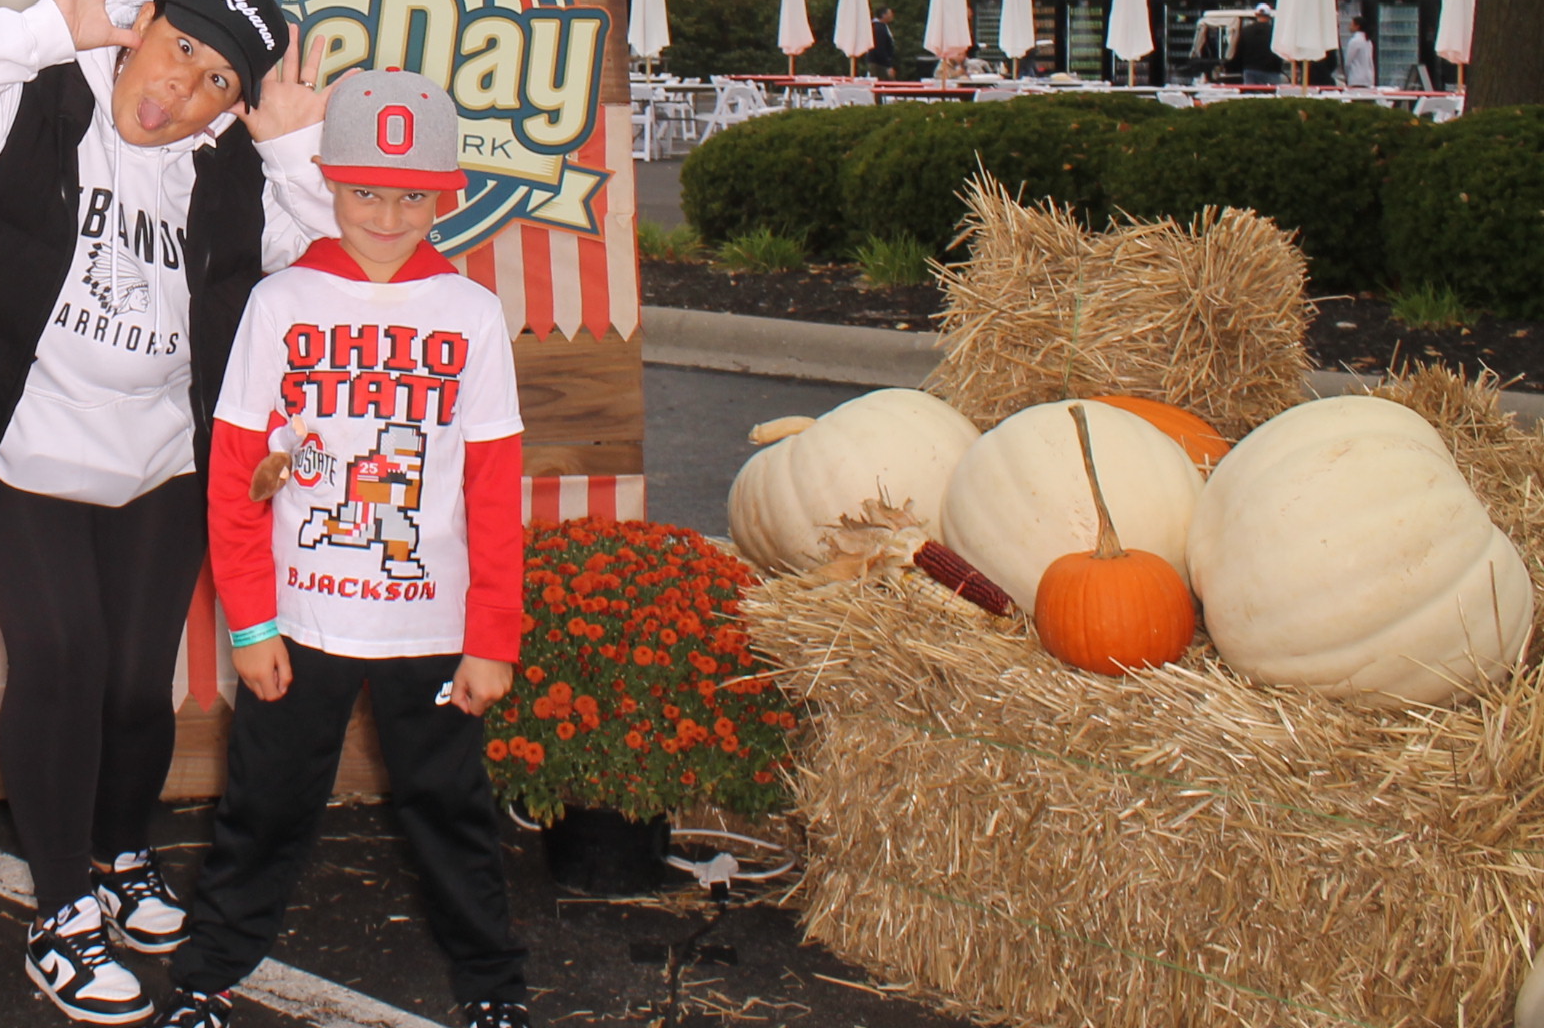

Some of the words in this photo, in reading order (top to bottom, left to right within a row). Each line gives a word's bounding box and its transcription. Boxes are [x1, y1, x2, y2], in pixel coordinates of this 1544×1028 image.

[375, 104, 415, 157] O
[462, 134, 513, 160] RK
[54, 302, 179, 356] ARRIORS
[283, 323, 469, 377] OHIO
[359, 462, 379, 474] 25
[287, 566, 436, 602] B.JACKSON
[440, 680, 454, 697] NI
